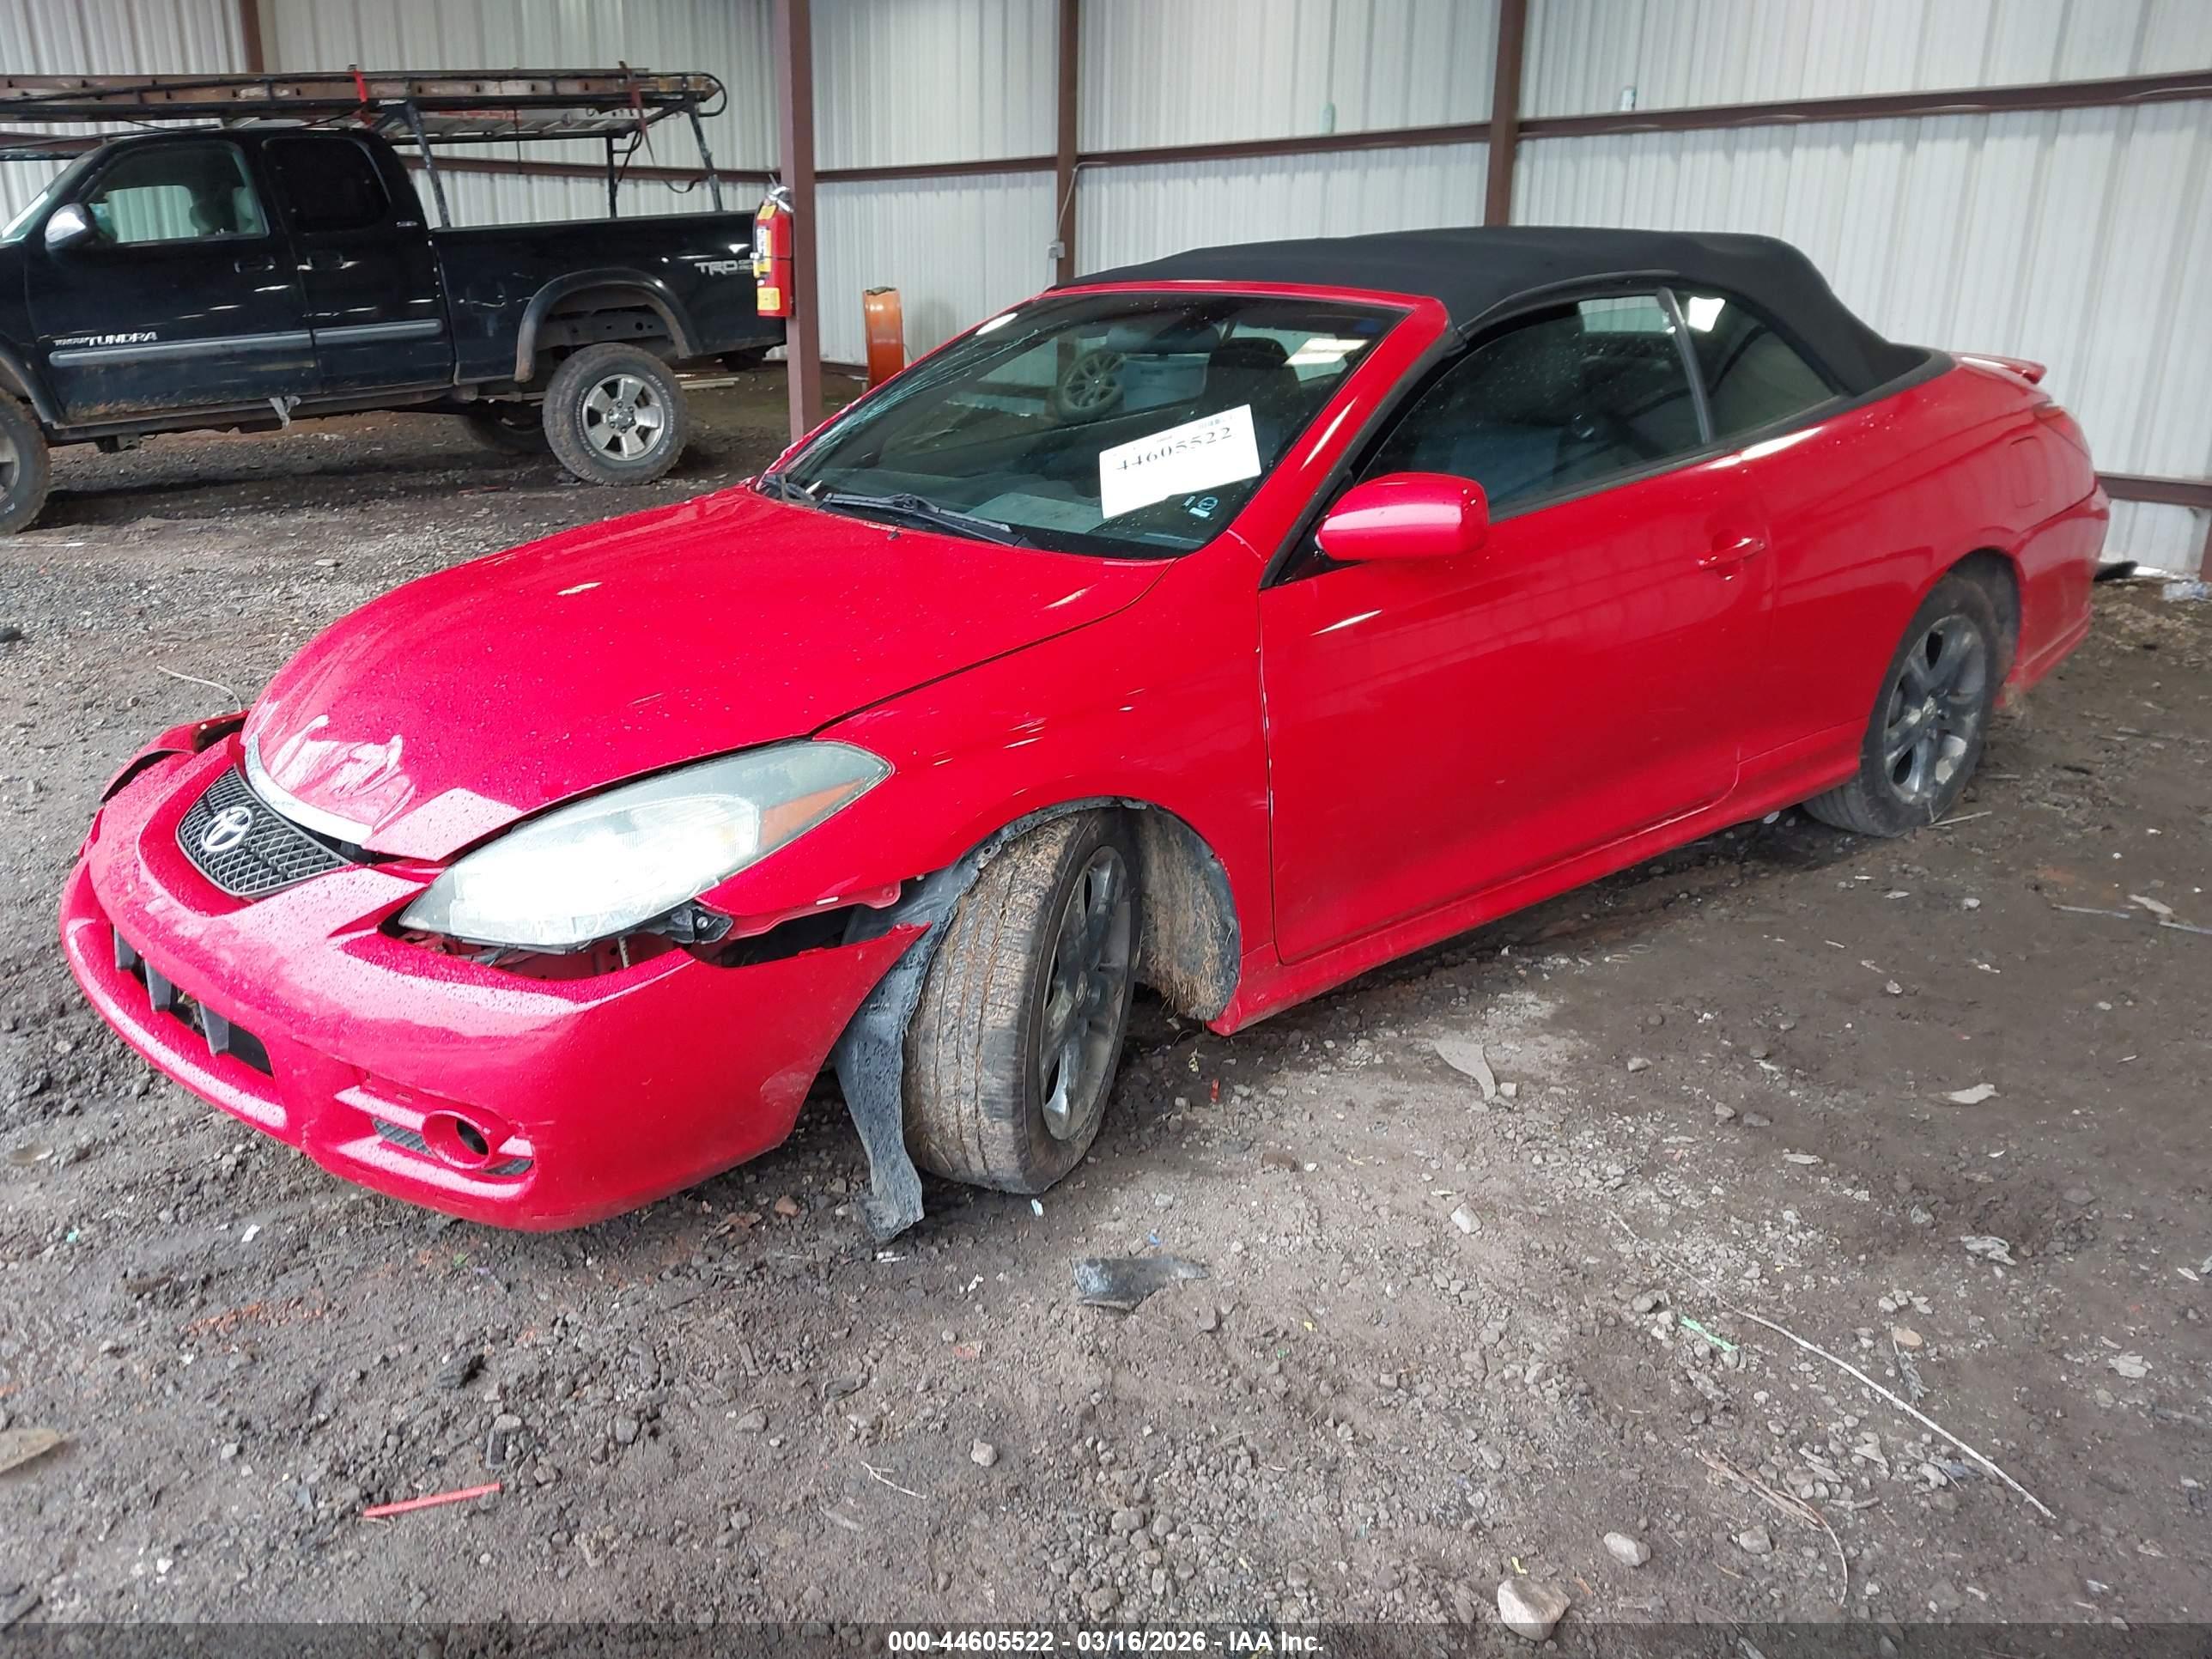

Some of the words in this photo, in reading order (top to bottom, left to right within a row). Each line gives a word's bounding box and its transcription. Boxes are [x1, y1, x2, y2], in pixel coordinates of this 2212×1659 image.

[694, 259, 738, 276] TRD
[88, 331, 158, 346] TUNDRA
[1117, 427, 1231, 470] 44605522
